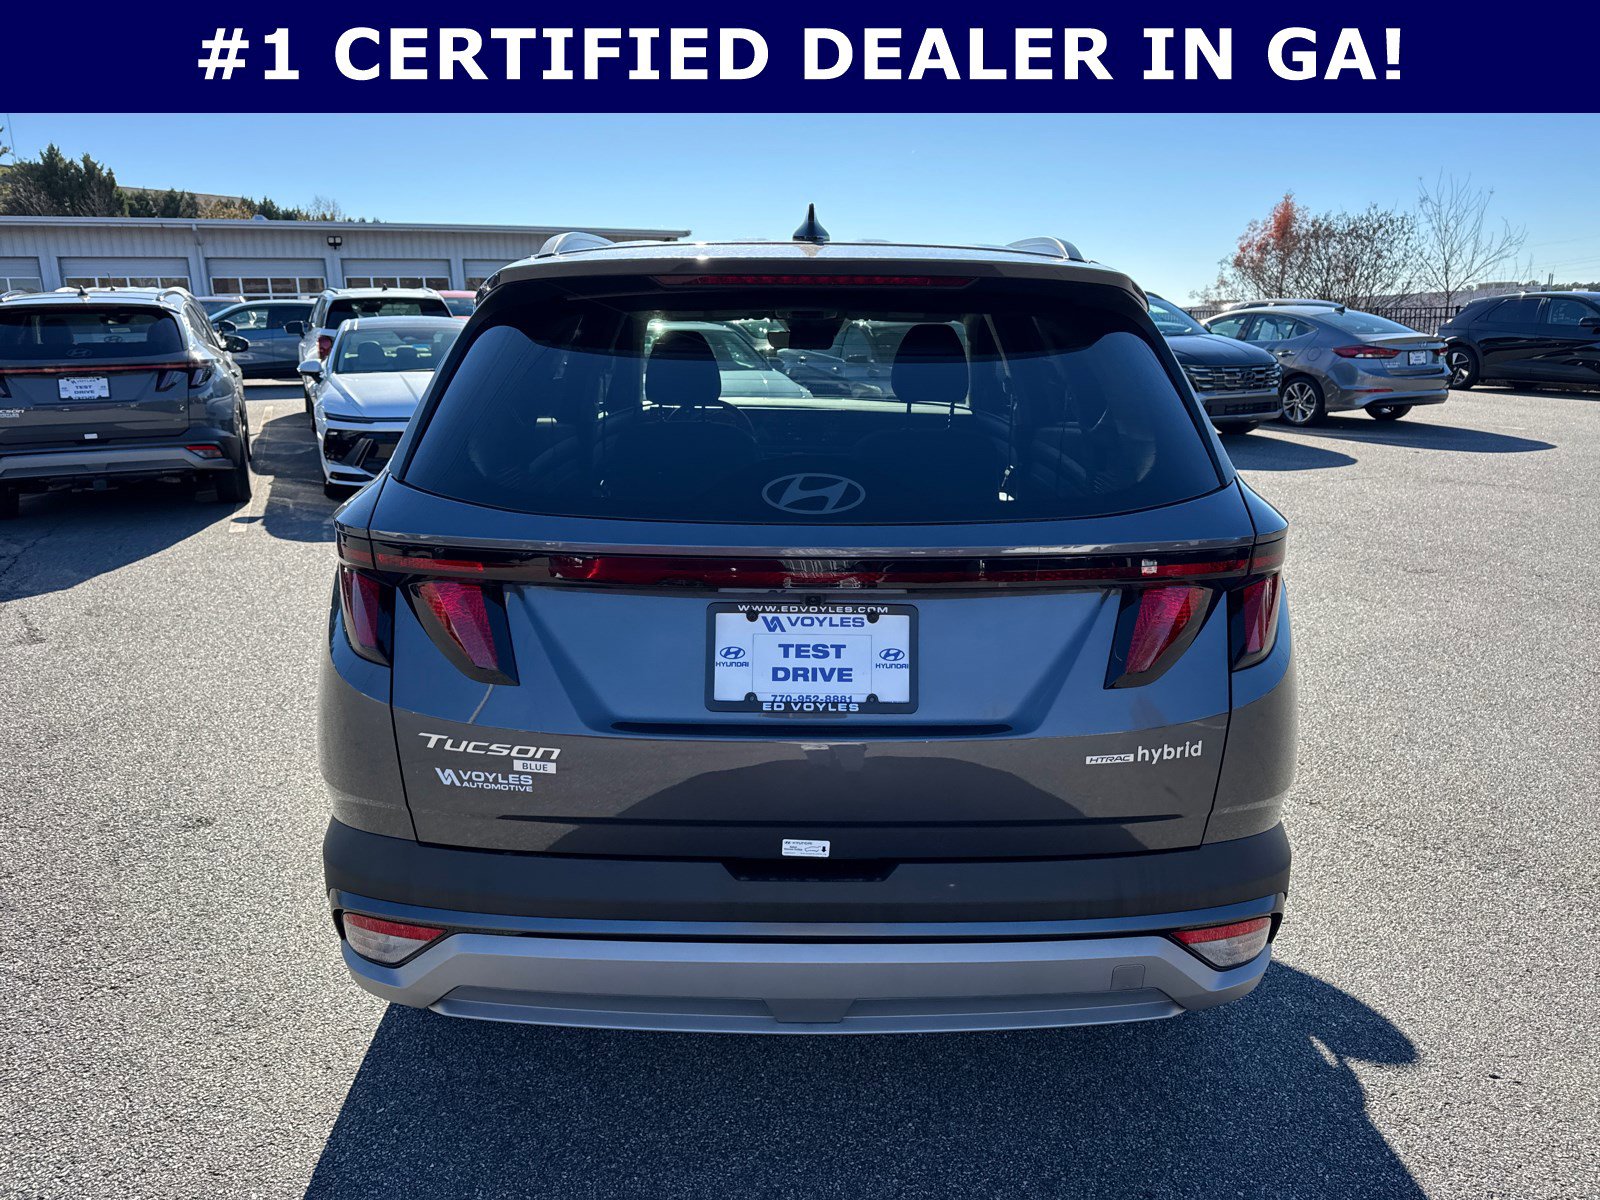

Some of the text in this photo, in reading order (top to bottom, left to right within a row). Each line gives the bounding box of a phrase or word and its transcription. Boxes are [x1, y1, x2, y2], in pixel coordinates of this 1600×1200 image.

[737, 604, 889, 614] WWW.EDVOYLES.COM
[786, 616, 866, 628] VOYLES
[777, 643, 847, 659] TEST
[875, 662, 910, 670] HYUNDAI
[771, 666, 853, 683] DRIVE
[770, 694, 853, 703] 770-952-8881
[762, 702, 860, 712] ED VOYLES
[1089, 740, 1203, 765] HTRAC hybrid
[521, 762, 549, 772] BLUE
[458, 769, 533, 785] VOYLES
[461, 781, 534, 792] AUTOMOTIVE
